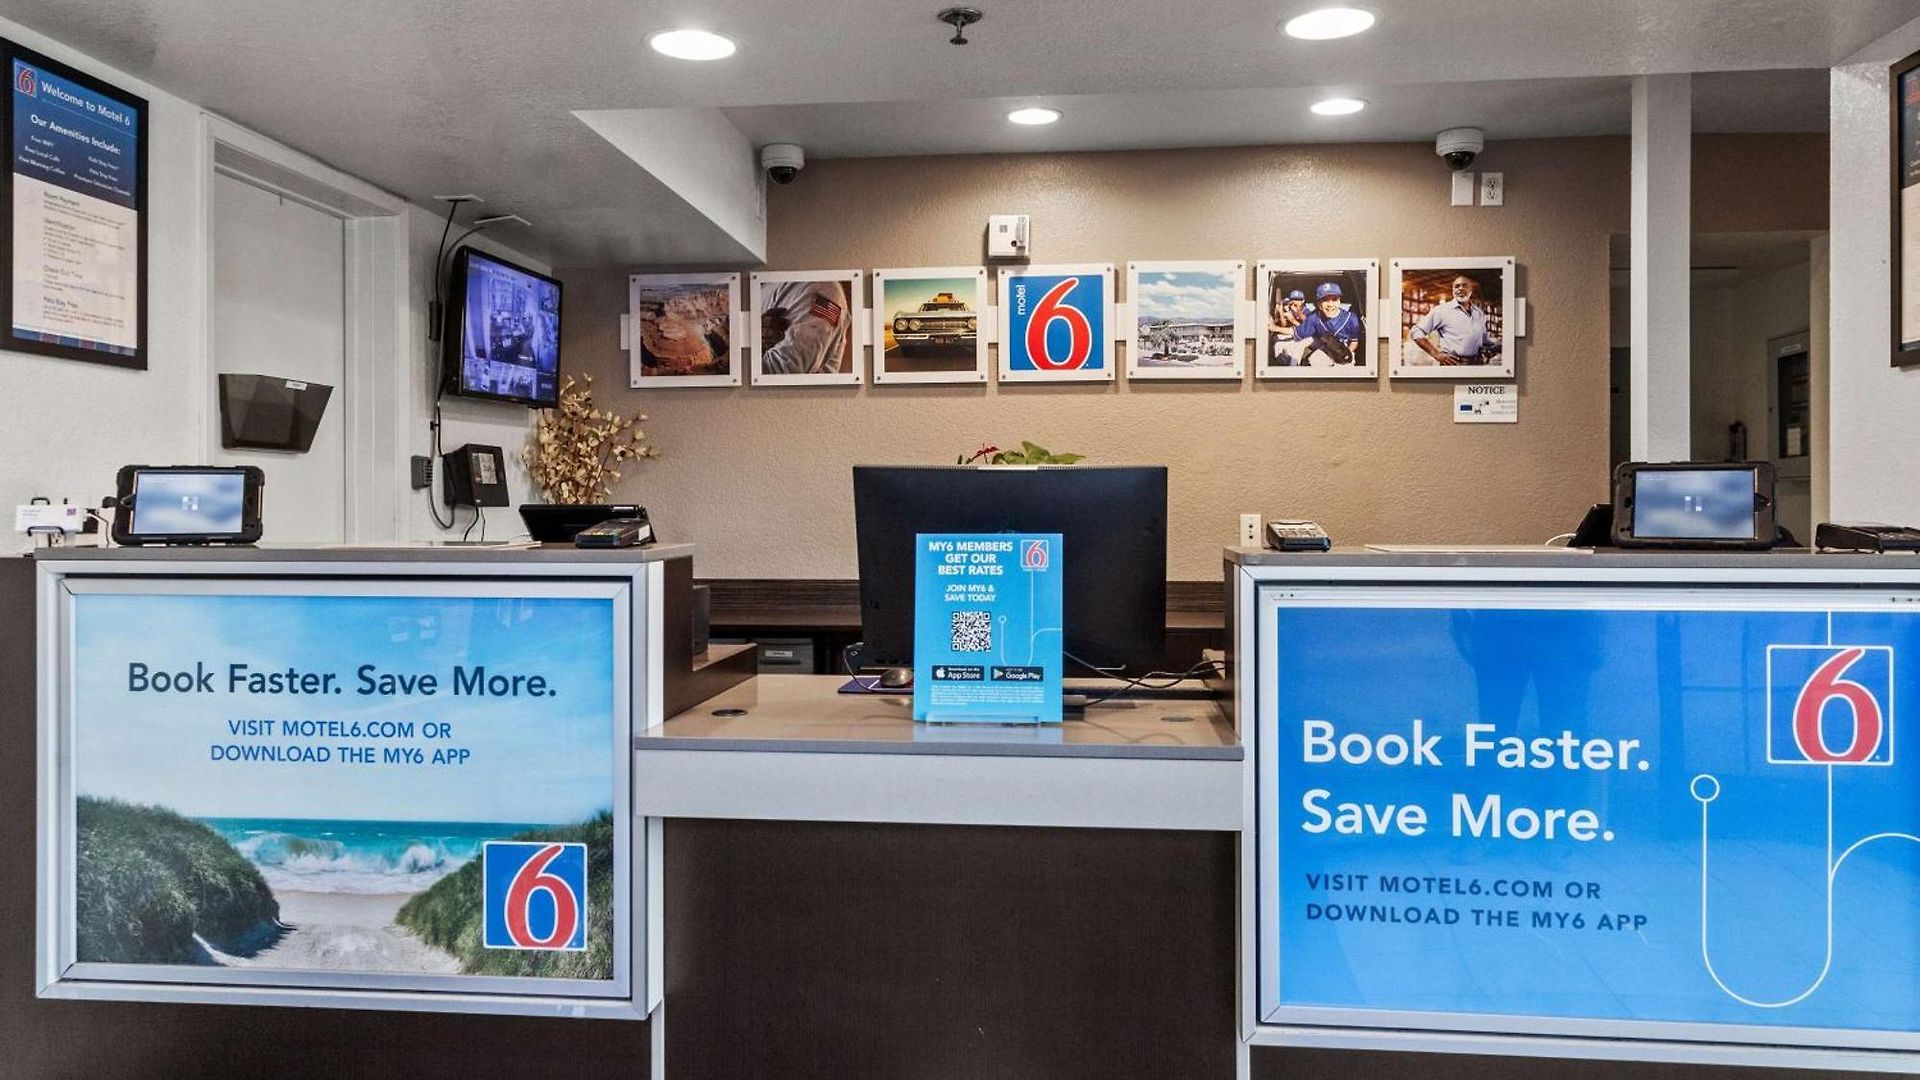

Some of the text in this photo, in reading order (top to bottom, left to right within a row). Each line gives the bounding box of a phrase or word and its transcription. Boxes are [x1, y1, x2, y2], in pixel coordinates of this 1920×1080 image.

[19, 67, 34, 95] 6
[41, 80, 130, 126] Welcome to Motel 6
[31, 114, 121, 155] Our Amenities Include:
[1016, 277, 1092, 371] motel 6
[1468, 386, 1505, 395] NOTICE
[928, 541, 1014, 552] MY6 MEMBERS
[945, 553, 997, 564] GET OUR
[938, 565, 1004, 575] BEST RATES
[944, 594, 997, 602] SAVE TODAY
[946, 584, 966, 592] JOIN
[968, 584, 986, 592] MY6
[128, 662, 557, 697] Book Faster. Save More.
[948, 671, 981, 680] App Store
[1005, 672, 1041, 681] Google Play
[1792, 648, 1883, 763] 6
[228, 719, 451, 739] VISIT MOTEL6.COM OR
[210, 744, 471, 765] DOWNLOAD THE MY6 APP
[1303, 719, 1650, 771] Book Faster.
[1302, 788, 1615, 842] Save More.
[504, 844, 579, 949] 6
[1305, 873, 1600, 899] VISIT MOTEL6.COM OR
[1306, 903, 1648, 931] DOWNLOAD THE MY6 APP
